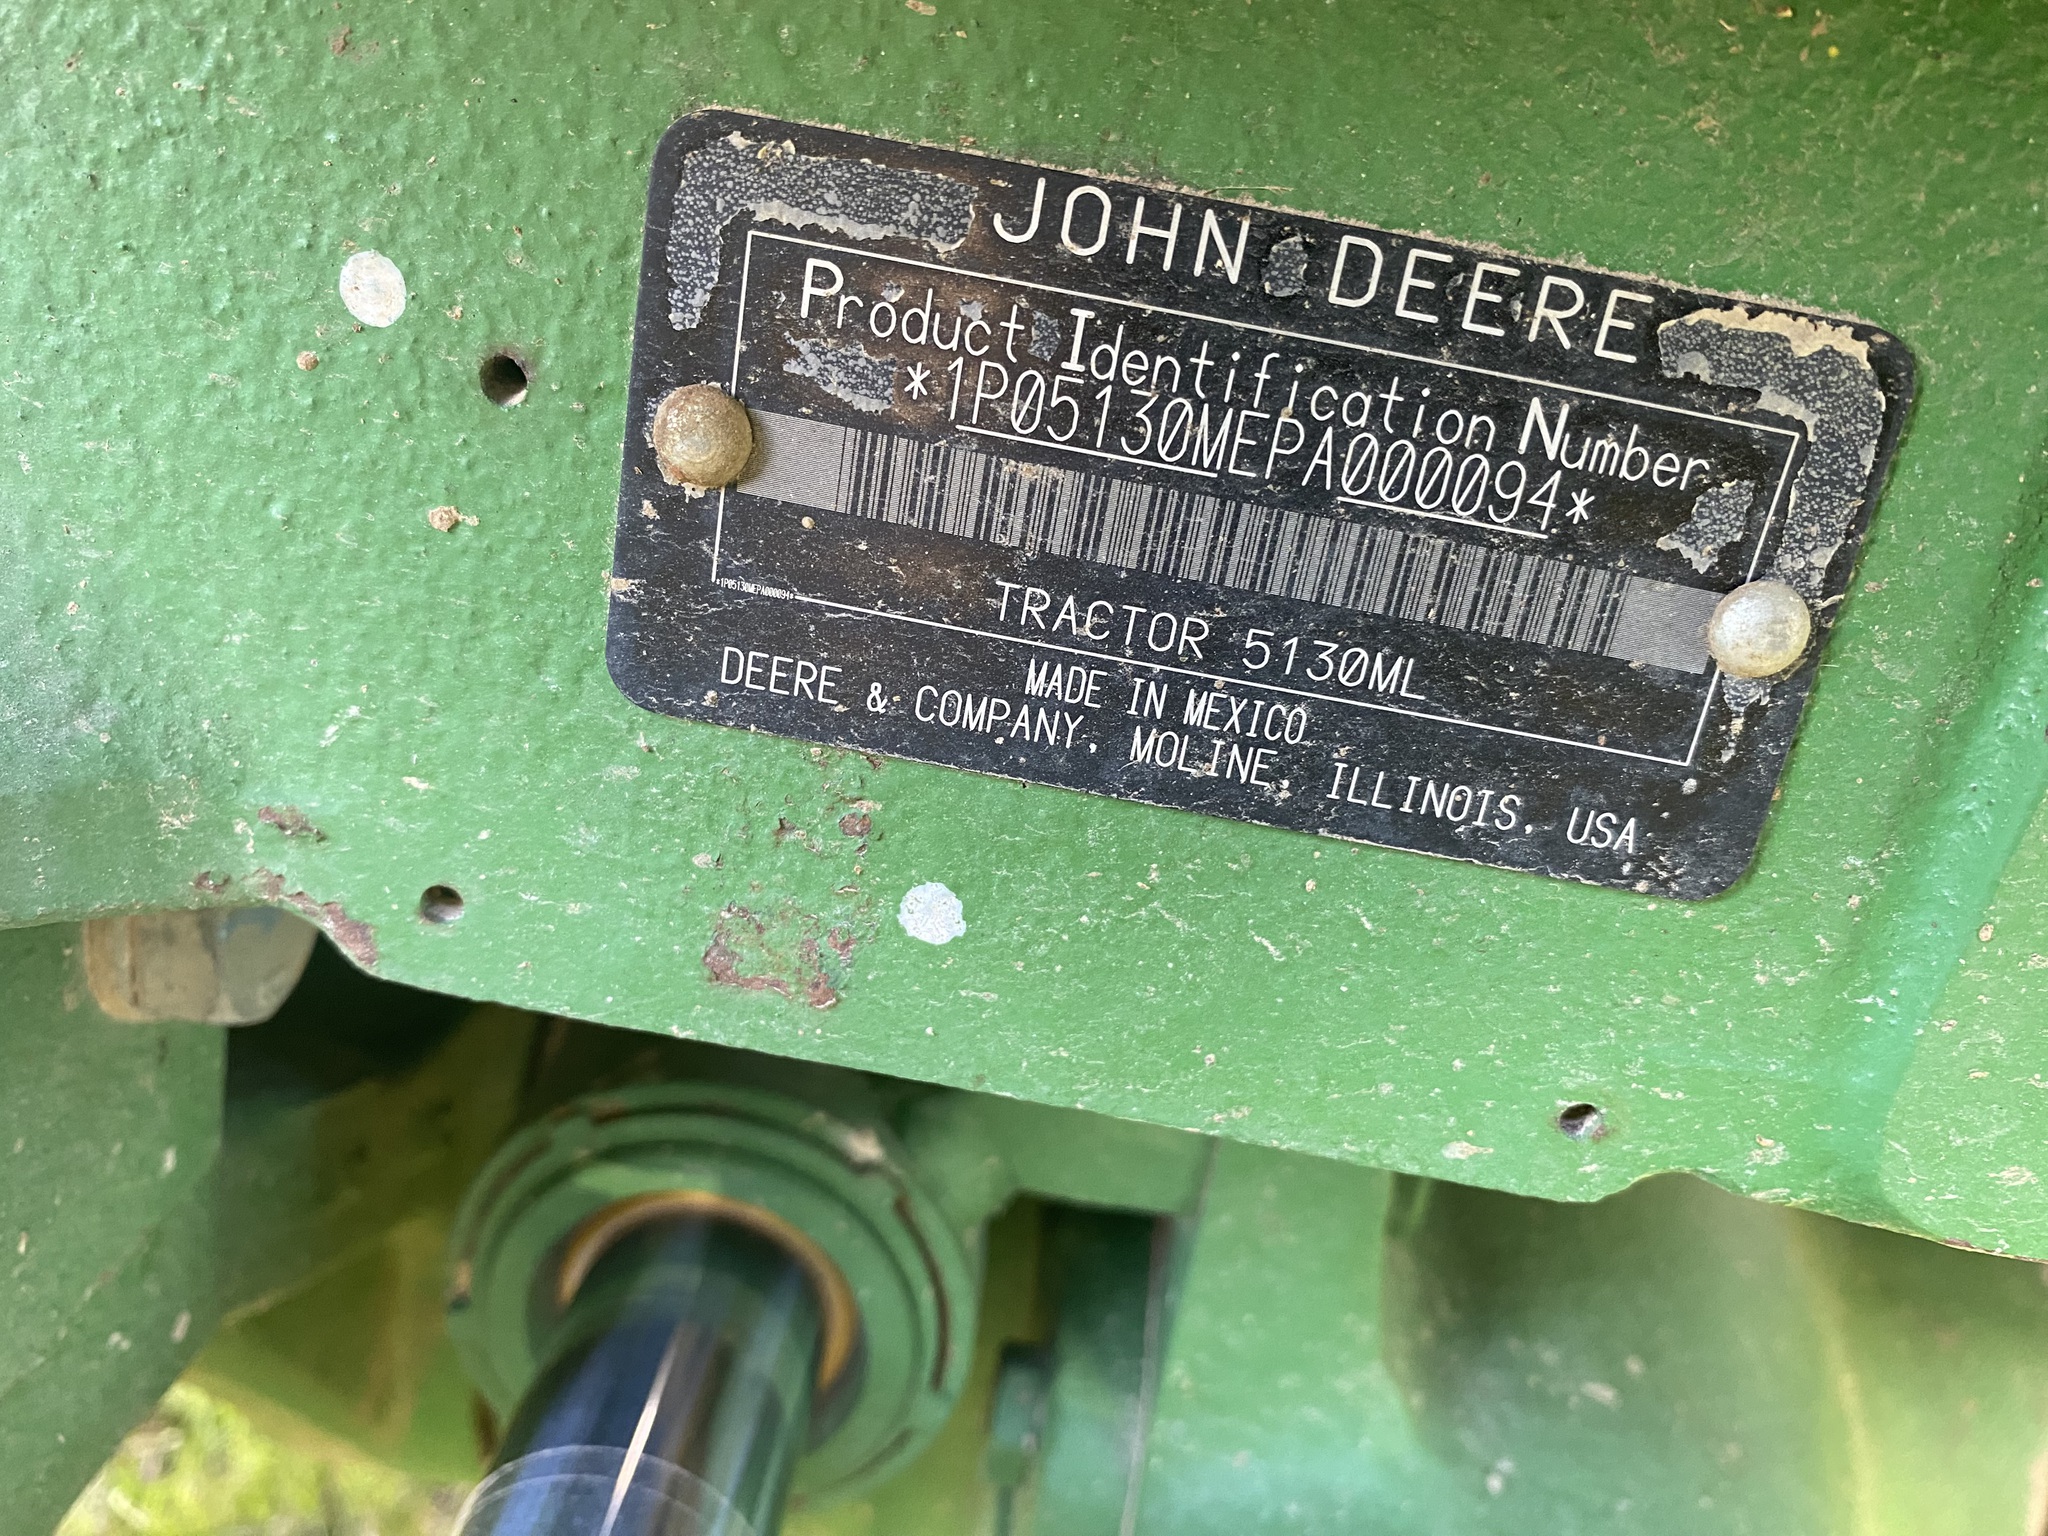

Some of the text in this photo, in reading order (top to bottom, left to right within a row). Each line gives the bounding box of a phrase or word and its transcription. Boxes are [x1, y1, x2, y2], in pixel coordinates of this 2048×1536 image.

[992, 177, 1655, 364] JOHN DEERE
[800, 257, 1710, 490] Product Identification Number
[996, 581, 1426, 700] TRACTOR 5130ML
[1025, 658, 1308, 745] MADE IN MEXICO
[720, 646, 843, 705] DEERE
[866, 682, 890, 714] &
[1566, 807, 1637, 854] USA
